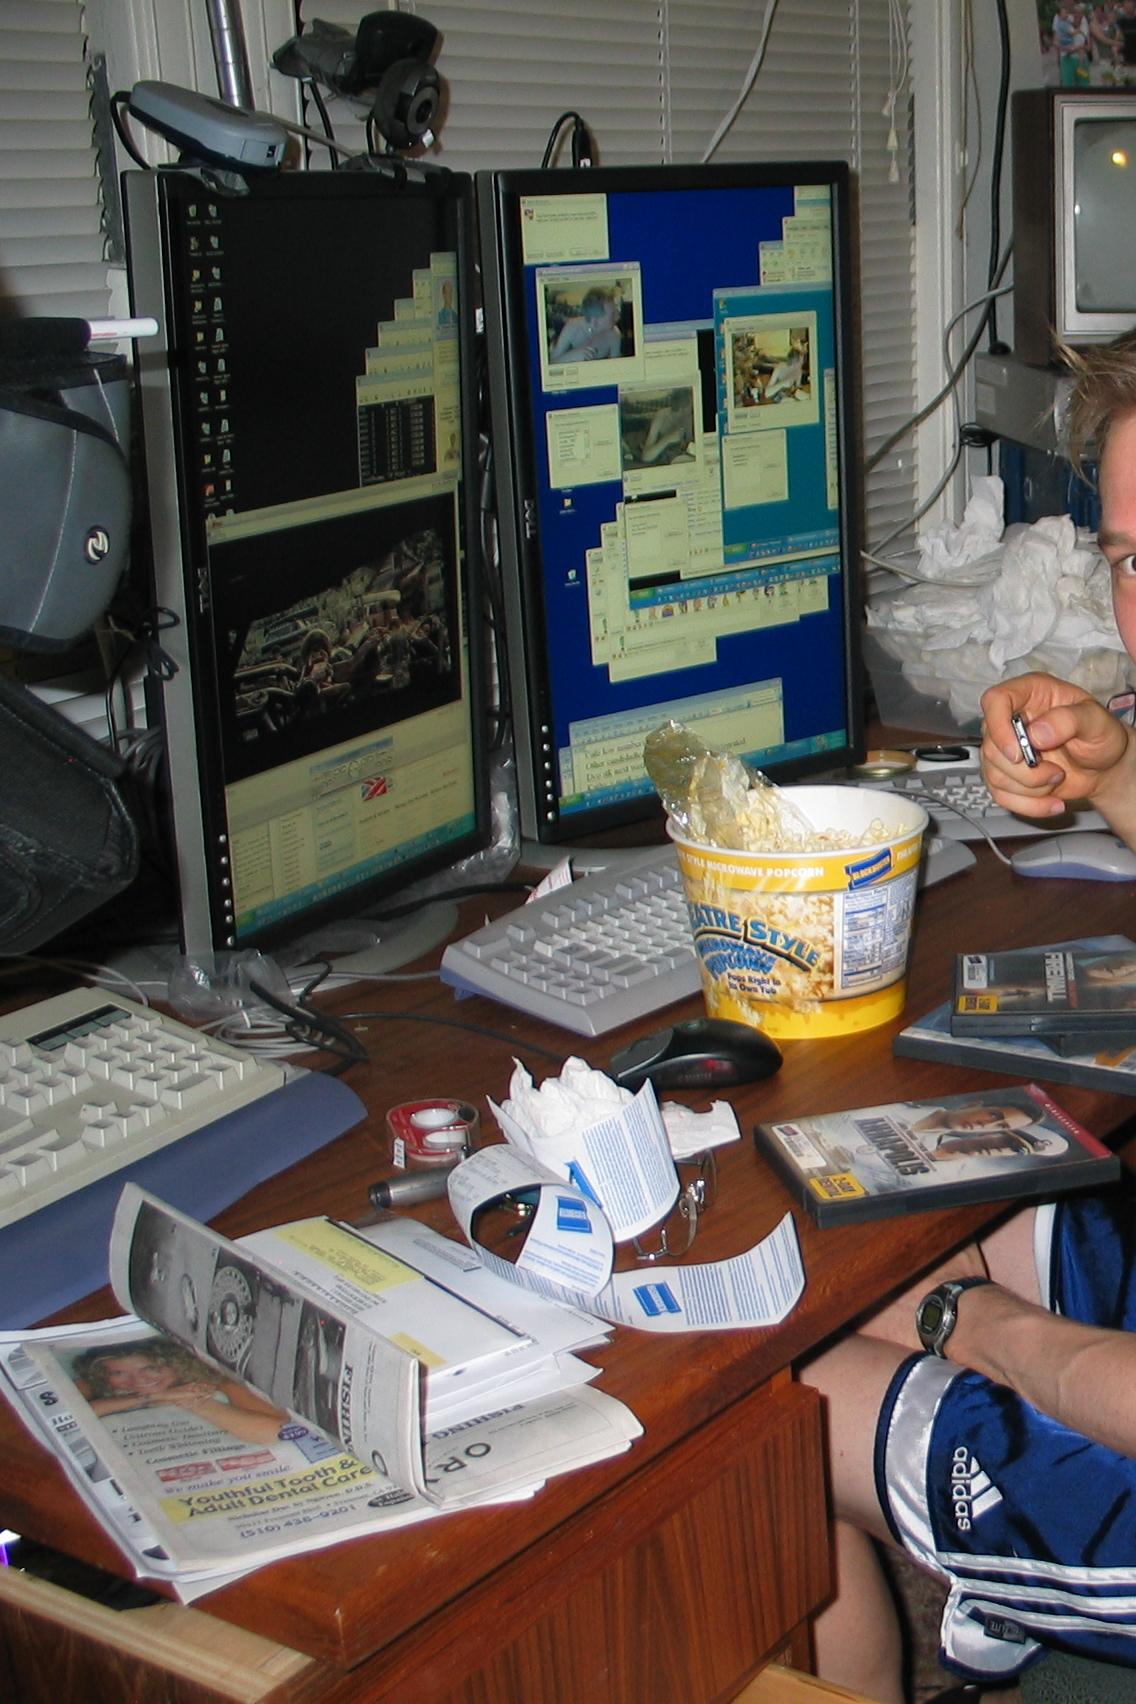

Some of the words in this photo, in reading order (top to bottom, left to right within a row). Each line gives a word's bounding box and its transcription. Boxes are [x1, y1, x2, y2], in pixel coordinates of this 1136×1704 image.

[706, 858, 764, 878] MICROWAVE
[766, 866, 824, 879] POPCORN
[747, 918, 822, 967] STYLE
[1044, 951, 1068, 1003] FIREWALL
[178, 1481, 274, 1508] Youthful
[274, 1466, 338, 1490] Tooth
[340, 1457, 360, 1470] &
[187, 1499, 246, 1519] Adult
[250, 1482, 320, 1506] Dental
[322, 1465, 374, 1488] Care
[952, 1446, 972, 1531] adidas
[240, 1523, 282, 1539] (510)
